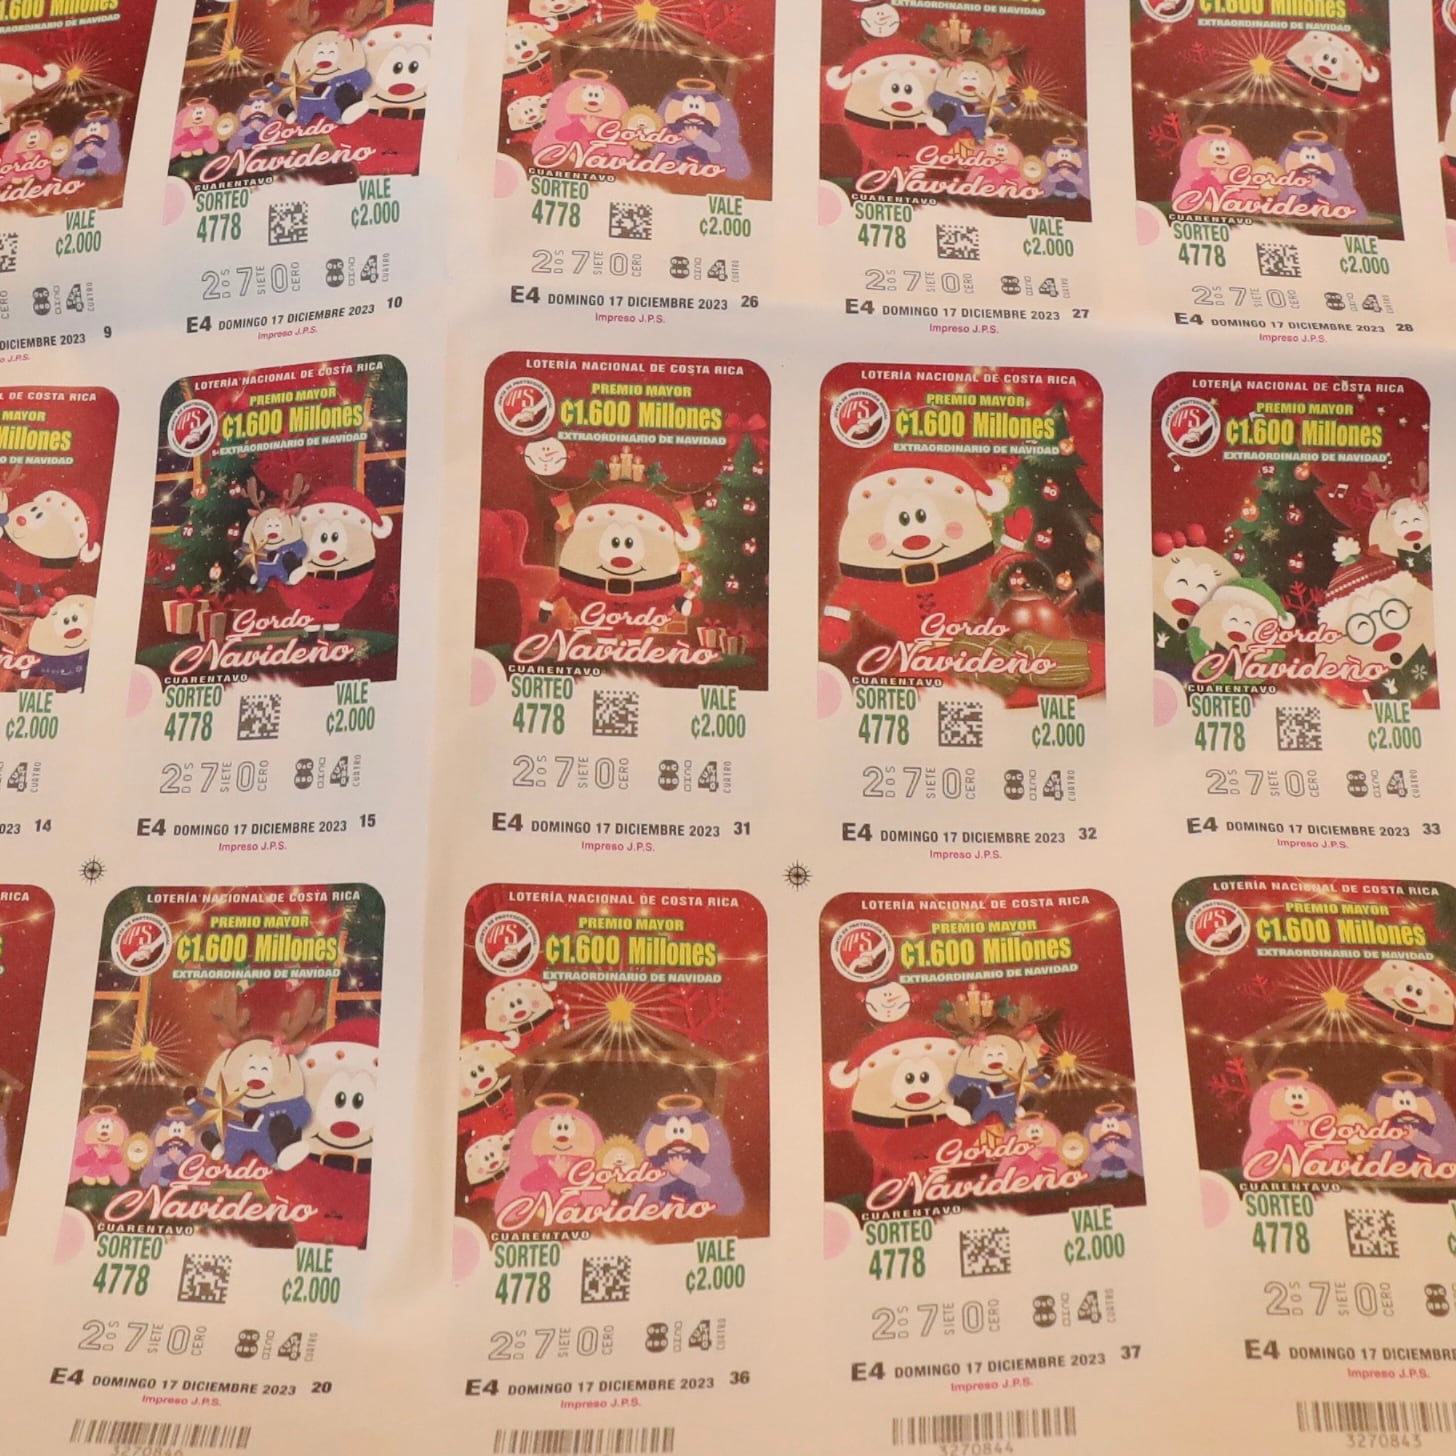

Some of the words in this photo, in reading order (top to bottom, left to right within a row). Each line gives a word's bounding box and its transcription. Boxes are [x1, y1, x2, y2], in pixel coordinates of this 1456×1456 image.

[984, 4, 996, 12] DE
[999, 6, 1045, 15] NAVIDAD
[531, 178, 589, 199] SORTEO
[1221, 166, 1312, 191] Gordo
[532, 200, 581, 228] 4778
[709, 196, 742, 215] VALE
[1169, 186, 1357, 219] Navideño
[186, 316, 212, 333] E4
[218, 316, 267, 331] DOMINGO
[271, 315, 284, 325] 17
[287, 308, 346, 323] DICIEMBRE
[348, 304, 375, 316] 2023
[387, 296, 402, 308] 10
[929, 324, 969, 333] Impreso
[249, 392, 294, 406] PREMIO
[296, 387, 336, 401] MAYOR
[1247, 381, 1308, 390] NACIONAL
[1313, 383, 1328, 391] DE
[1333, 383, 1371, 392] COSTA
[1376, 384, 1404, 393] RICA
[9, 456, 23, 464] DE
[25, 456, 73, 464] NAVIDAD
[913, 613, 1010, 642] Gordo
[508, 665, 601, 676] CUARENTAVO
[856, 640, 1057, 676] Navideño
[568, 893, 635, 904] NACIONAL
[640, 895, 656, 905] DE
[662, 896, 702, 906] COSTA
[708, 897, 738, 907] RICA
[982, 934, 1072, 964] Millones
[1299, 1115, 1410, 1146] Gordo
[861, 1205, 962, 1222] CUARENTAVO
[97, 1235, 163, 1260] SORTEO
[294, 1248, 334, 1273] VALE
[92, 1262, 151, 1297] 4778
